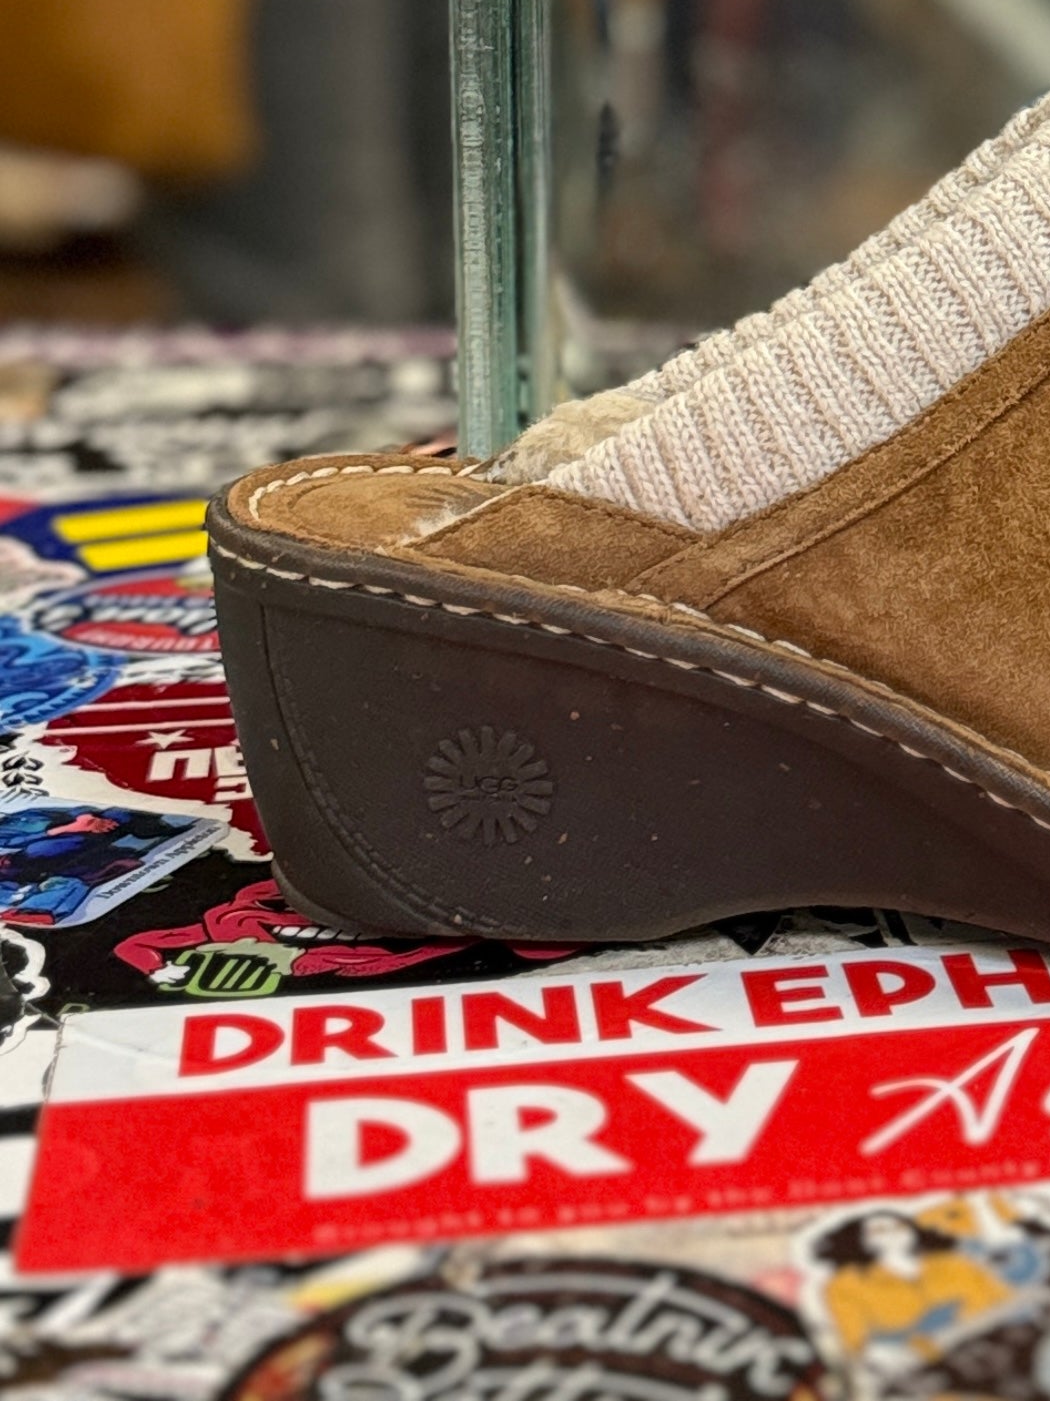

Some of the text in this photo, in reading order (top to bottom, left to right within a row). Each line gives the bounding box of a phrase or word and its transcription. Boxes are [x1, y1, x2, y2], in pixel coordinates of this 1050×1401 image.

[459, 775, 519, 793] UGG
[96, 826, 220, 900] Downtown Appleton
[178, 972, 722, 1077] DRINK
[302, 1058, 800, 1200] DRY
